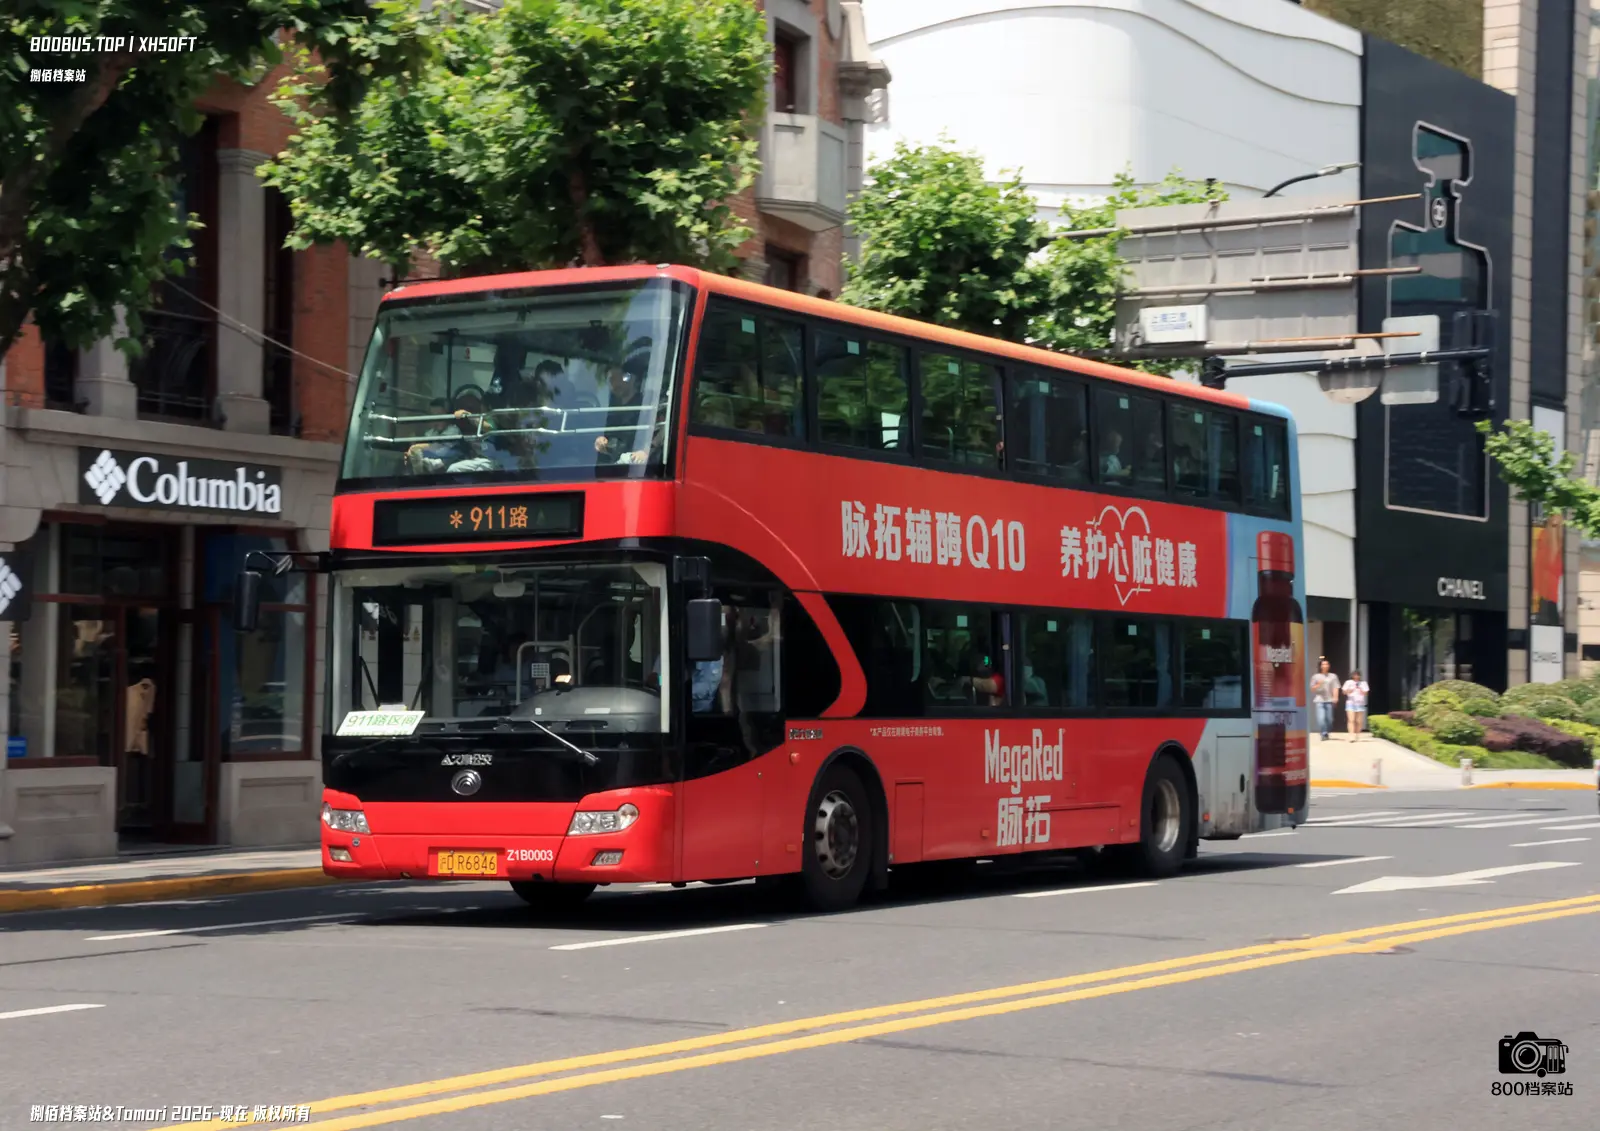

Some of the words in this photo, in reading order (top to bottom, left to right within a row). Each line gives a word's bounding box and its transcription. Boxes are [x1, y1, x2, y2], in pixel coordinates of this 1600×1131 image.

[127, 457, 282, 513] Columbia
[470, 505, 529, 531] 911路
[841, 501, 1026, 573] 脉拓辅酶Q10
[1060, 525, 1199, 588] 养护心脏健康
[1437, 576, 1486, 601] CHANEL
[984, 728, 1064, 795] MegaRed
[996, 795, 1051, 847] 脉拓
[507, 849, 554, 861] Z1B0003
